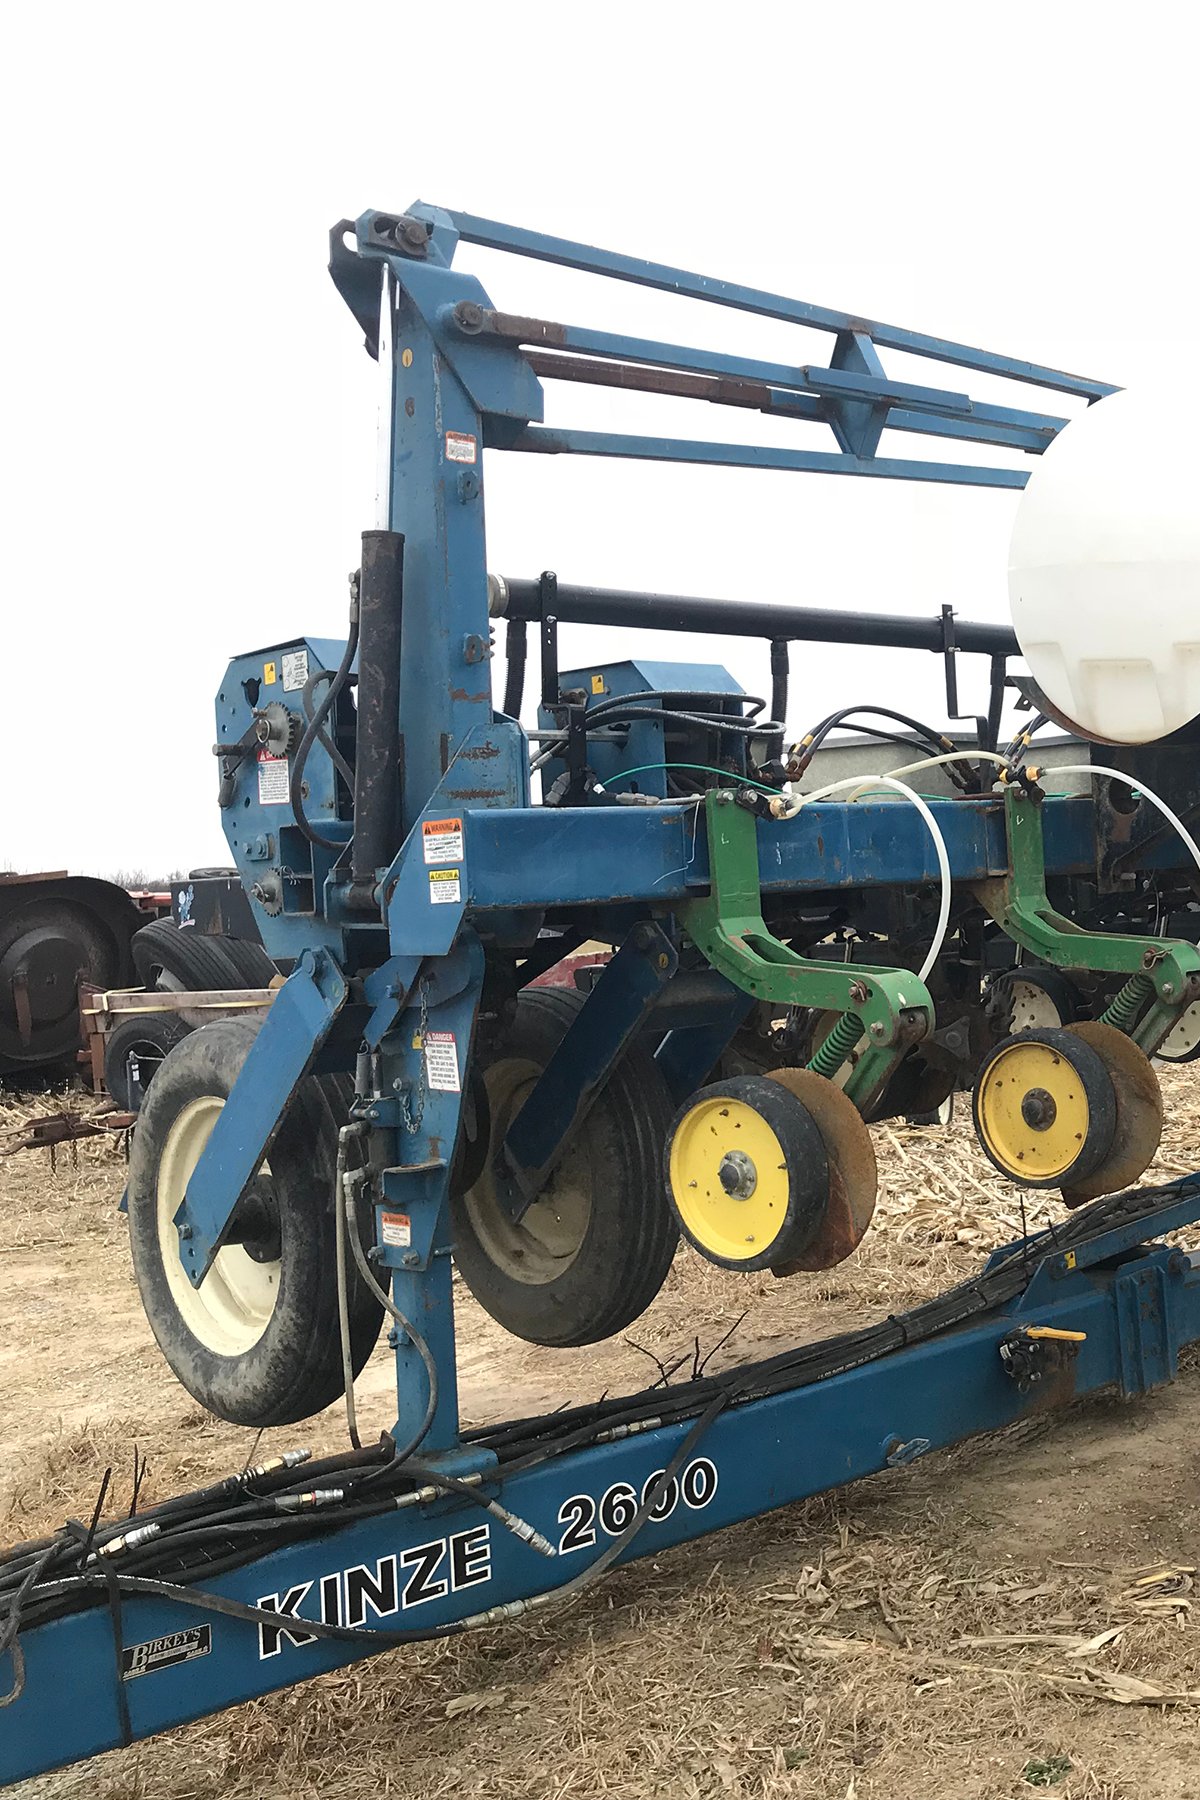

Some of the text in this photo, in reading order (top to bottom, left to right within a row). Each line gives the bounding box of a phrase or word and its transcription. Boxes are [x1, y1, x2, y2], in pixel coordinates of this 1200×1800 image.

[431, 823, 453, 832] WARNING
[431, 1033, 453, 1041] DANGER
[257, 1457, 718, 1661] KINZE 2600
[130, 1628, 201, 1670] BIRKEY'S
